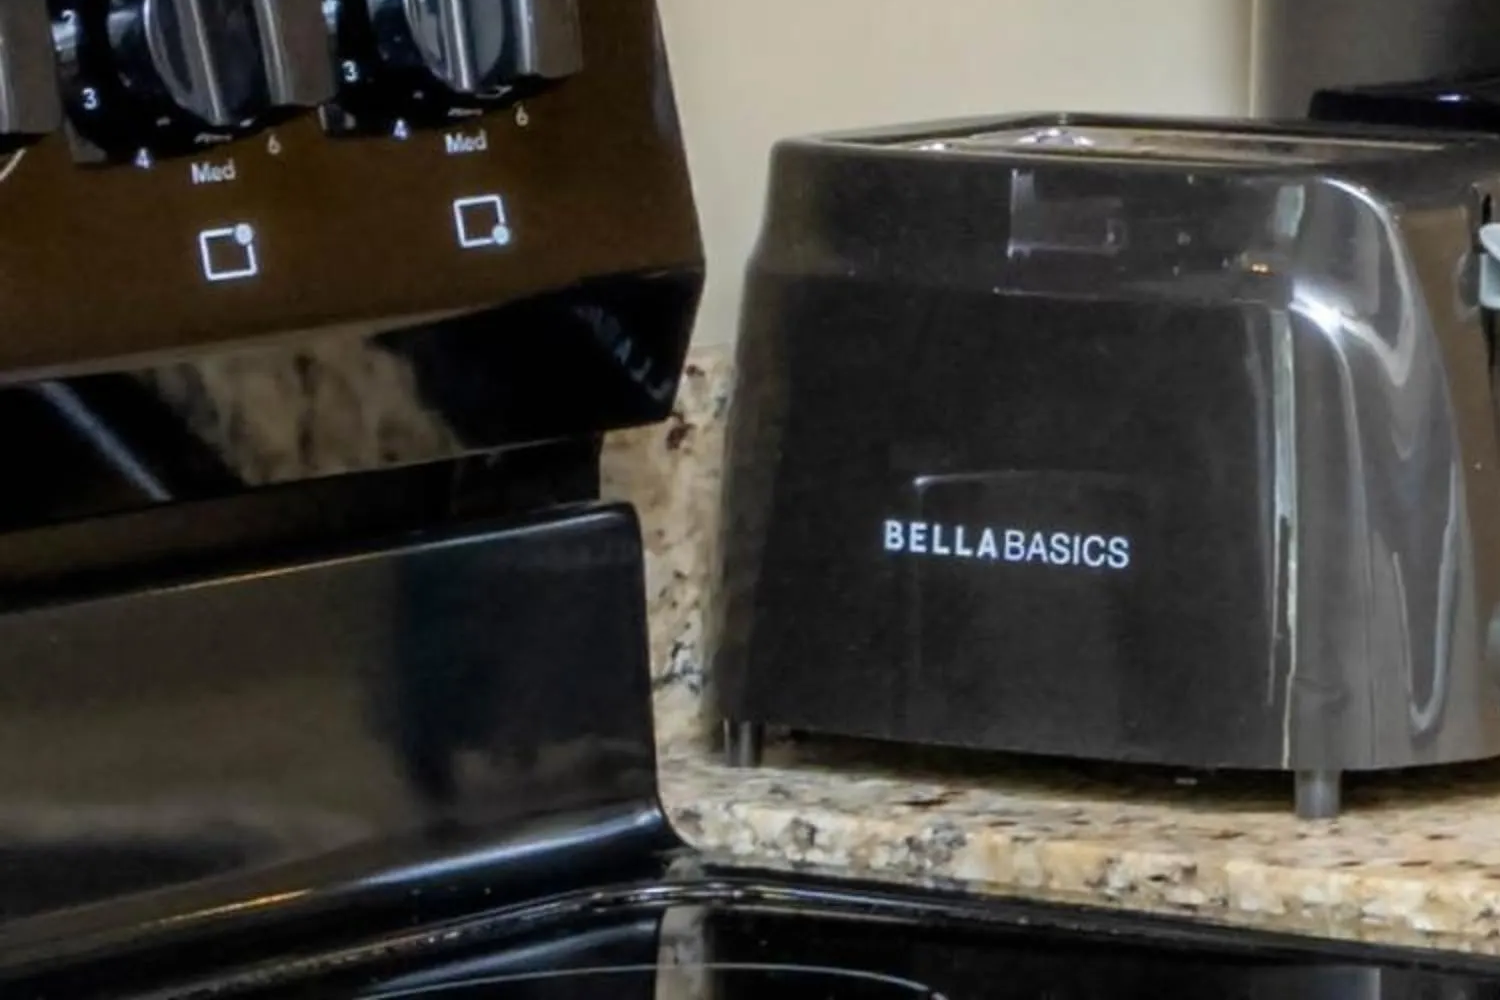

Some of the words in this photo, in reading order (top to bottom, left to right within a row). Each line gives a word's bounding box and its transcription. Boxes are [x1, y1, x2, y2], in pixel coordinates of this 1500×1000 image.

[342, 60, 358, 82] 3
[82, 87, 99, 110] 3
[515, 105, 529, 127] 6
[393, 119, 408, 140] 4
[267, 133, 281, 155] 6
[445, 128, 487, 154] Med
[135, 148, 150, 169] 4
[191, 158, 236, 185] Med
